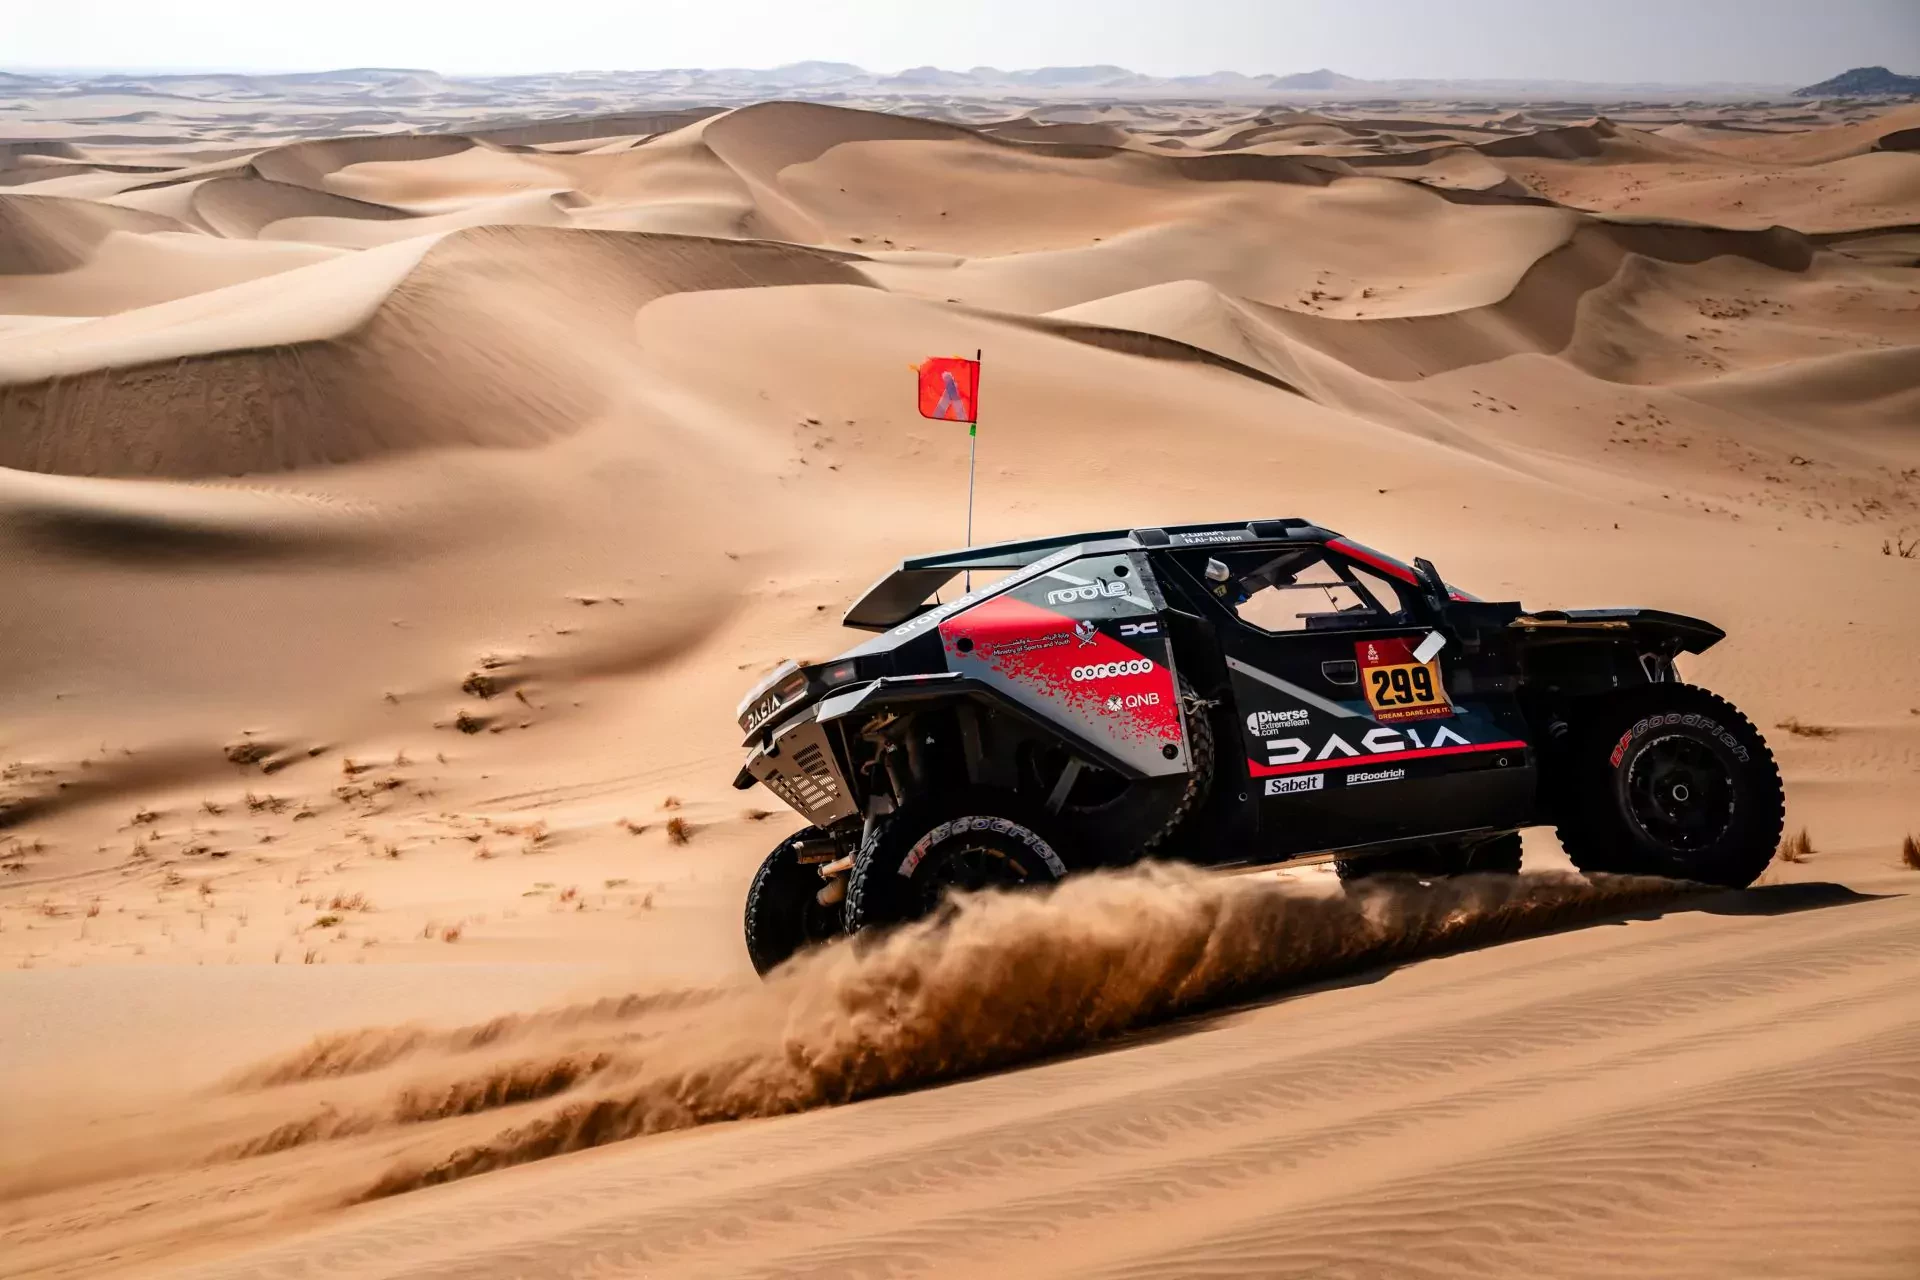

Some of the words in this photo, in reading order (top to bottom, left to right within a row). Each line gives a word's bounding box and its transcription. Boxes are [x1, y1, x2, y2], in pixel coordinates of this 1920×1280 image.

[894, 594, 975, 636] aramco
[993, 647, 1017, 656] Ministry
[1023, 643, 1043, 652] Sports
[1073, 660, 1152, 680] ooredoo
[1371, 666, 1435, 706] 299
[1125, 692, 1160, 708] QNB
[747, 693, 781, 730] DACIA
[1257, 709, 1309, 723] Diverse
[1378, 711, 1405, 720] DREAM.
[1405, 709, 1426, 717] DARE.
[1426, 707, 1440, 715] LIVE
[1259, 719, 1310, 730] ExtremeTeam
[1260, 729, 1279, 737] .com
[1610, 713, 1751, 768] BFGoodrich
[1266, 725, 1472, 765] DACIA
[1346, 768, 1405, 783] BFGoodrich
[1271, 776, 1318, 793] Sabelt
